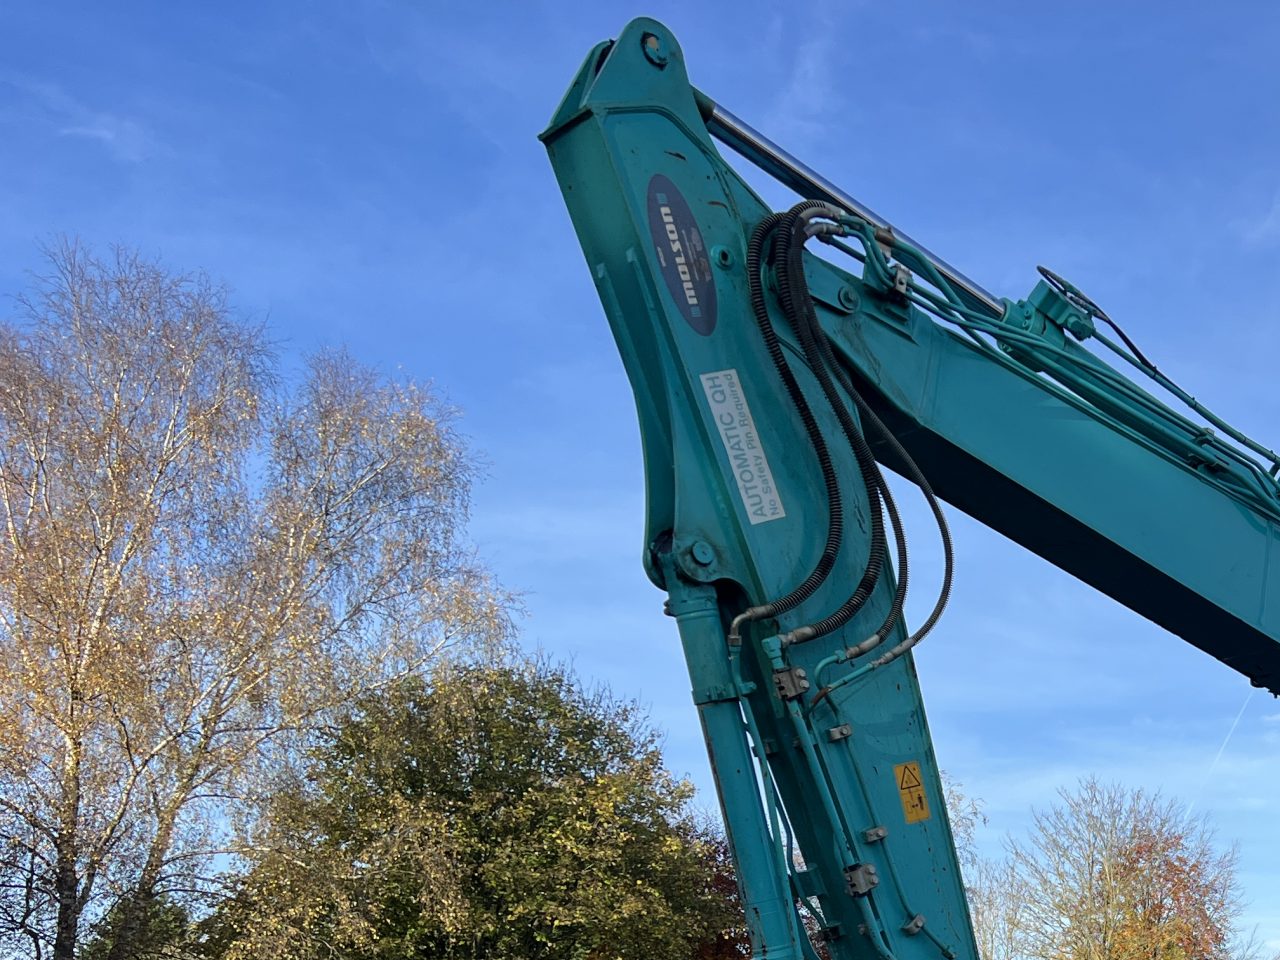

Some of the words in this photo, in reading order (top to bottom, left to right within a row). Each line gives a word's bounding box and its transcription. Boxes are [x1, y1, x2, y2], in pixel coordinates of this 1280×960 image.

[705, 375, 727, 404] QH
[723, 373, 749, 427] Required
[745, 431, 757, 450] Pin
[719, 412, 768, 517] AUTOMATIC
[753, 455, 772, 495] Safety
[768, 499, 780, 516] No
